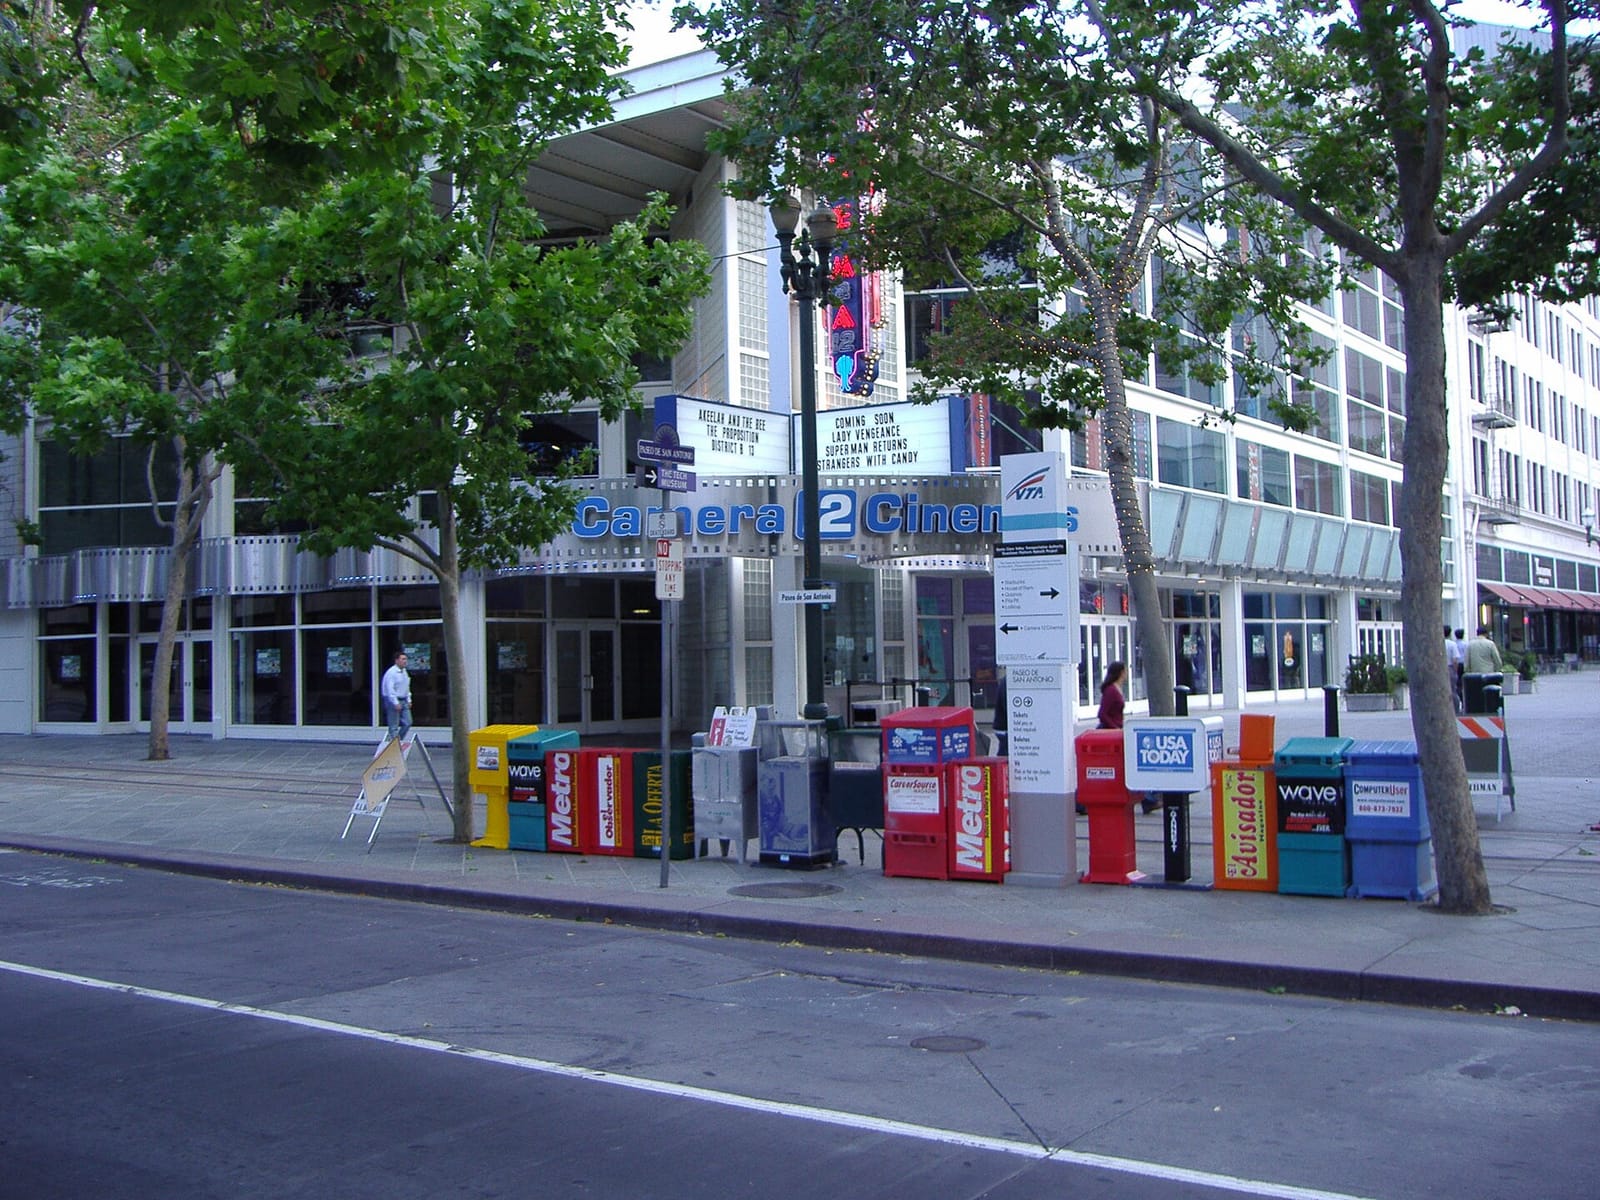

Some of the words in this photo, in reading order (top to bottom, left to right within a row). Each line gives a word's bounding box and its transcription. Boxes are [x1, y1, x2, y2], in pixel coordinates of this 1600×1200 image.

[699, 409, 725, 424] AKEELAH
[728, 414, 741, 427] AND
[742, 416, 752, 429] THE
[755, 418, 766, 431] BEE
[835, 415, 866, 429] COMING
[874, 412, 894, 425] SOON
[706, 424, 718, 437] THE
[722, 427, 760, 443] PROPOSITION
[832, 430, 851, 443] LADY
[855, 424, 901, 441] VENGEANCE
[655, 447, 661, 456] DE
[662, 448, 672, 457] SAN
[711, 439, 738, 454] DISTRICT
[739, 443, 743, 455] B
[749, 445, 754, 456] 13
[825, 442, 868, 457] SUPERMAN
[873, 438, 907, 453] RETURNS
[817, 456, 860, 471] STRANGERS
[866, 454, 886, 467] WITH
[891, 451, 918, 465] CANDY
[661, 469, 673, 478] THE
[673, 470, 687, 480] TECH
[661, 479, 687, 488] MUSEUM
[1014, 486, 1043, 501] VTA
[657, 542, 668, 556] NO
[658, 560, 682, 572] STOPPING
[664, 573, 676, 581] ANY
[664, 583, 676, 593] TIME
[781, 593, 795, 601] Paseo
[813, 592, 832, 600] Antonio
[1025, 675, 1054, 683] ANTONIO
[1155, 735, 1187, 750] USA
[1140, 749, 1189, 764] TODAY
[508, 765, 541, 778] wave
[890, 779, 936, 790] CareerSource
[551, 752, 572, 846] Metro
[1278, 785, 1336, 801] wave
[602, 765, 613, 839] Observador
[956, 766, 983, 870] Metro
[1231, 771, 1258, 877] Avisador
